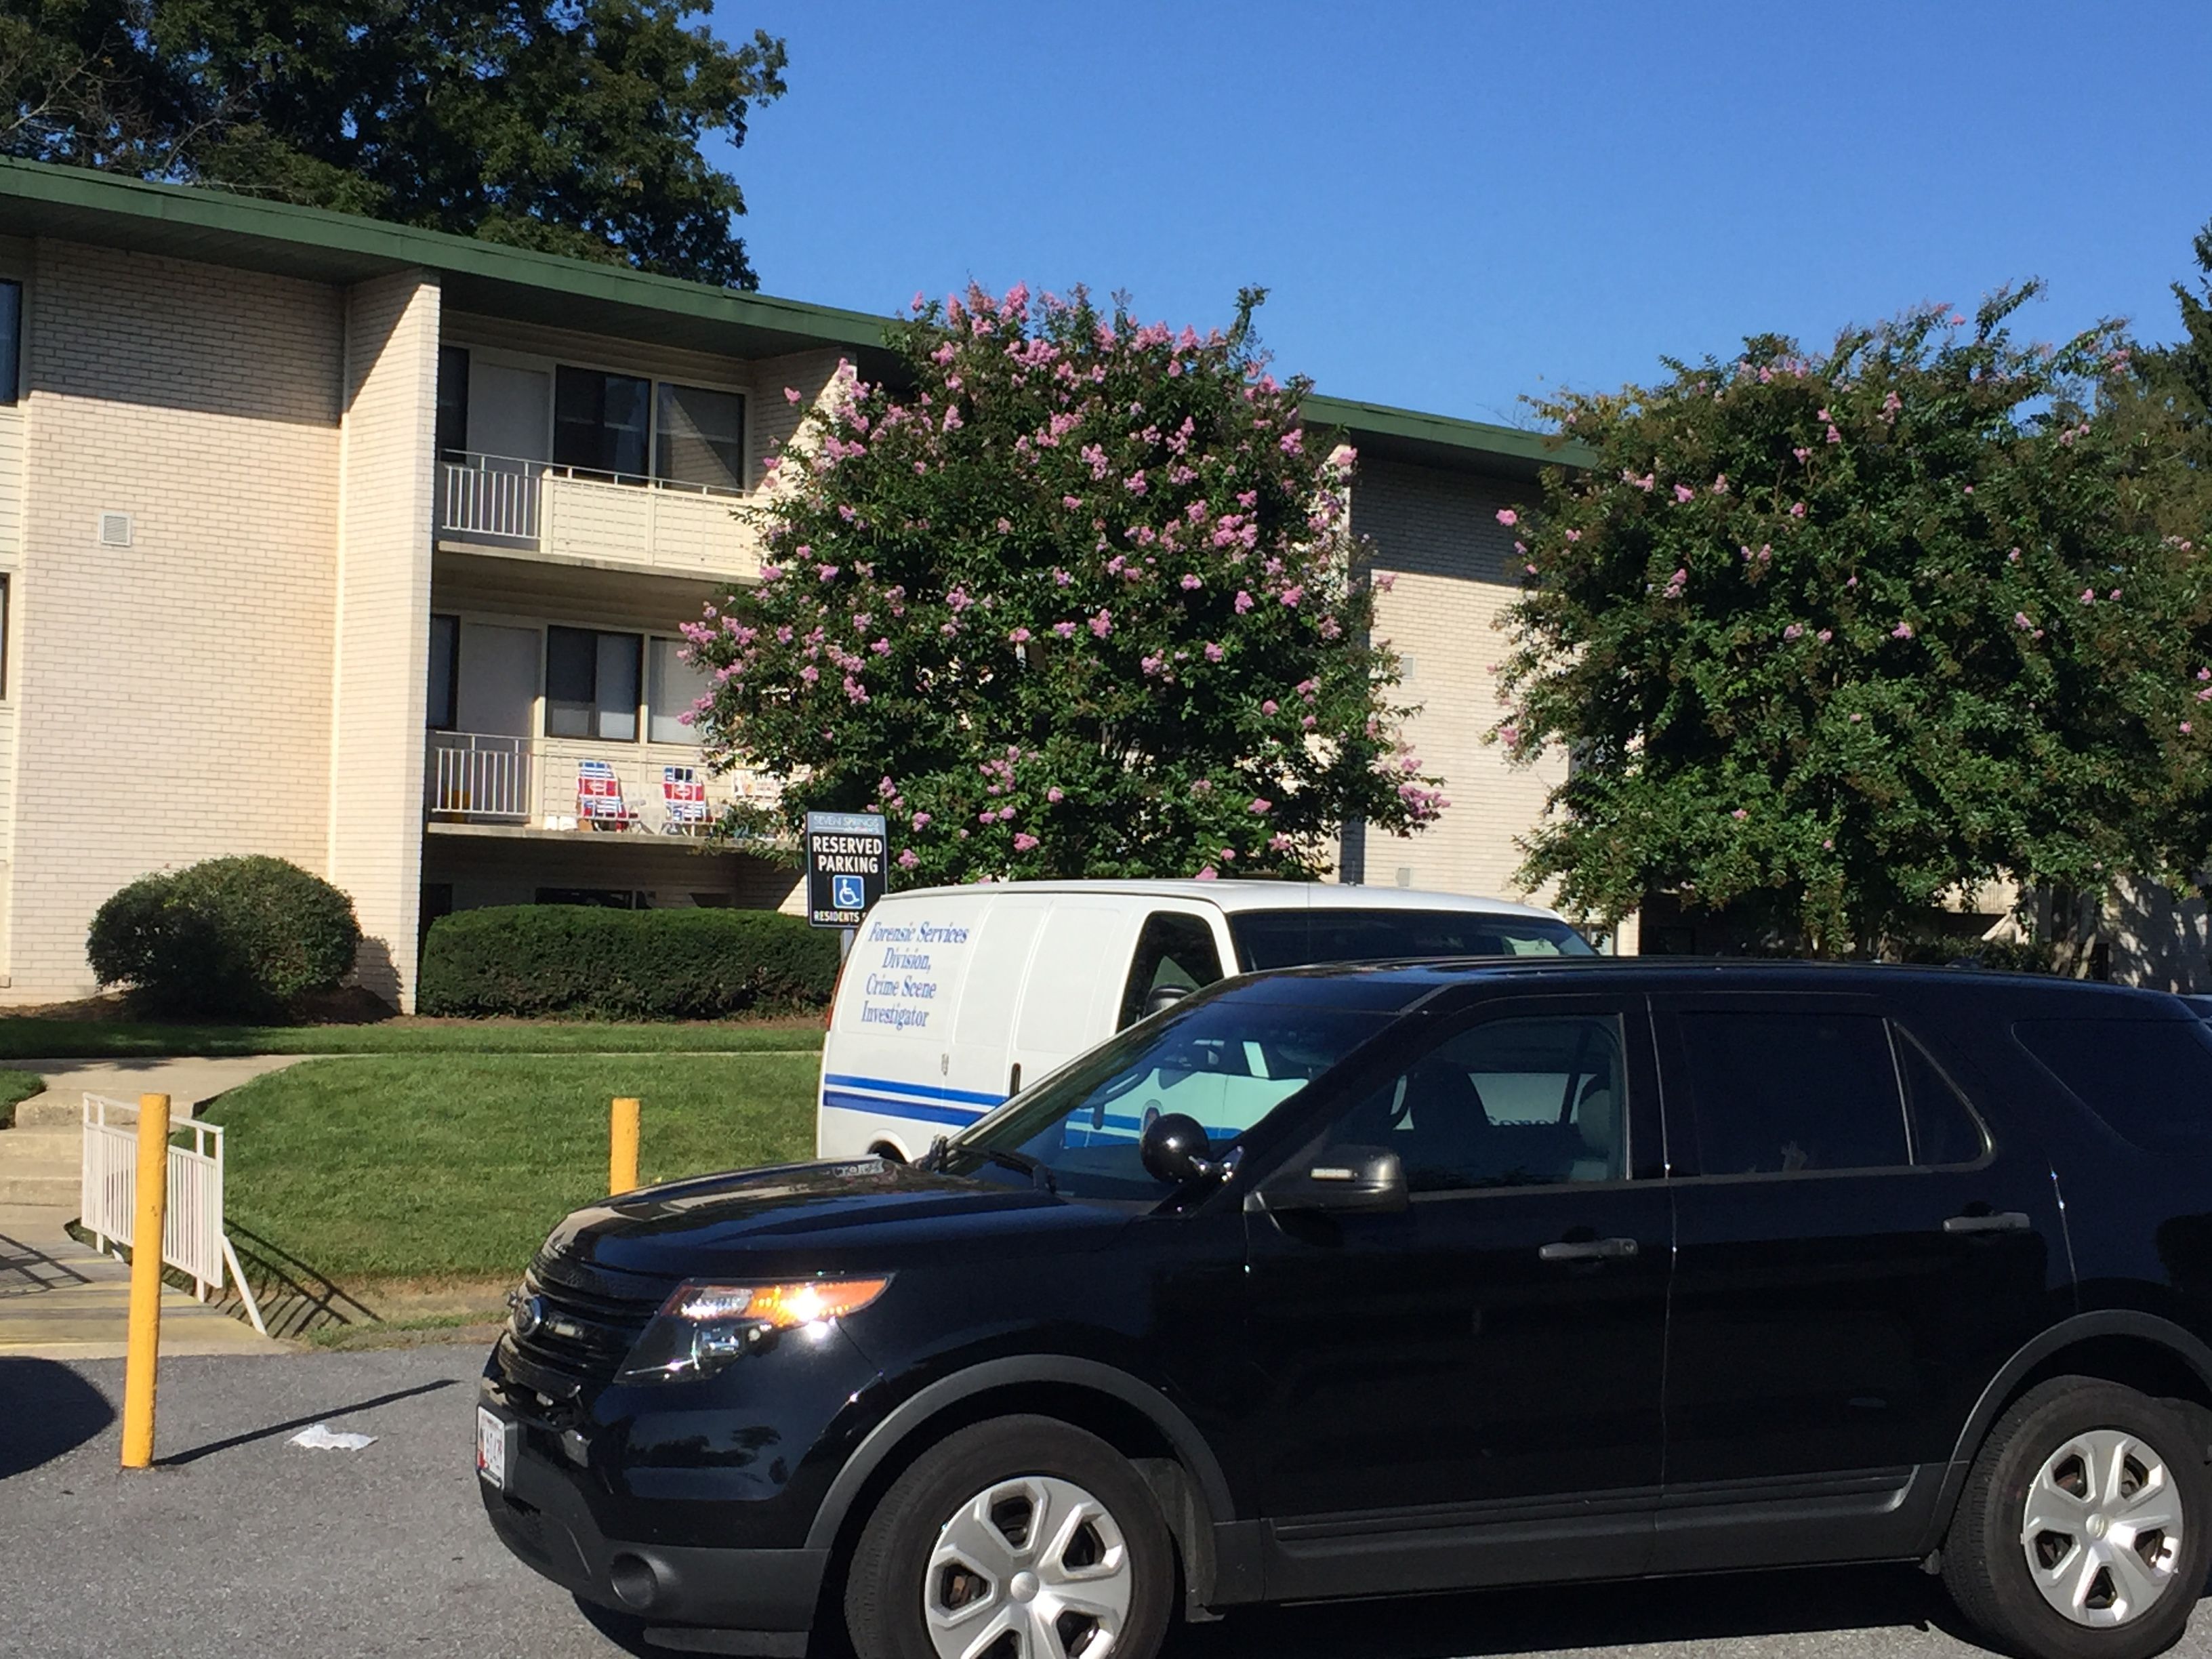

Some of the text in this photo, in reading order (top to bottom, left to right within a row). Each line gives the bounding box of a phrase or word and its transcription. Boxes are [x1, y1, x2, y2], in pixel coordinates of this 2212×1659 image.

[813, 815, 879, 827] SEVEN SPRINGS
[813, 836, 882, 855] RESERVED
[818, 855, 878, 874] PARKING
[814, 910, 860, 922] RESIDENTS
[869, 922, 969, 943] Forensic Services
[882, 947, 932, 974] Division,
[866, 973, 937, 998] Crime Scene
[861, 1000, 930, 1031] Investigator
